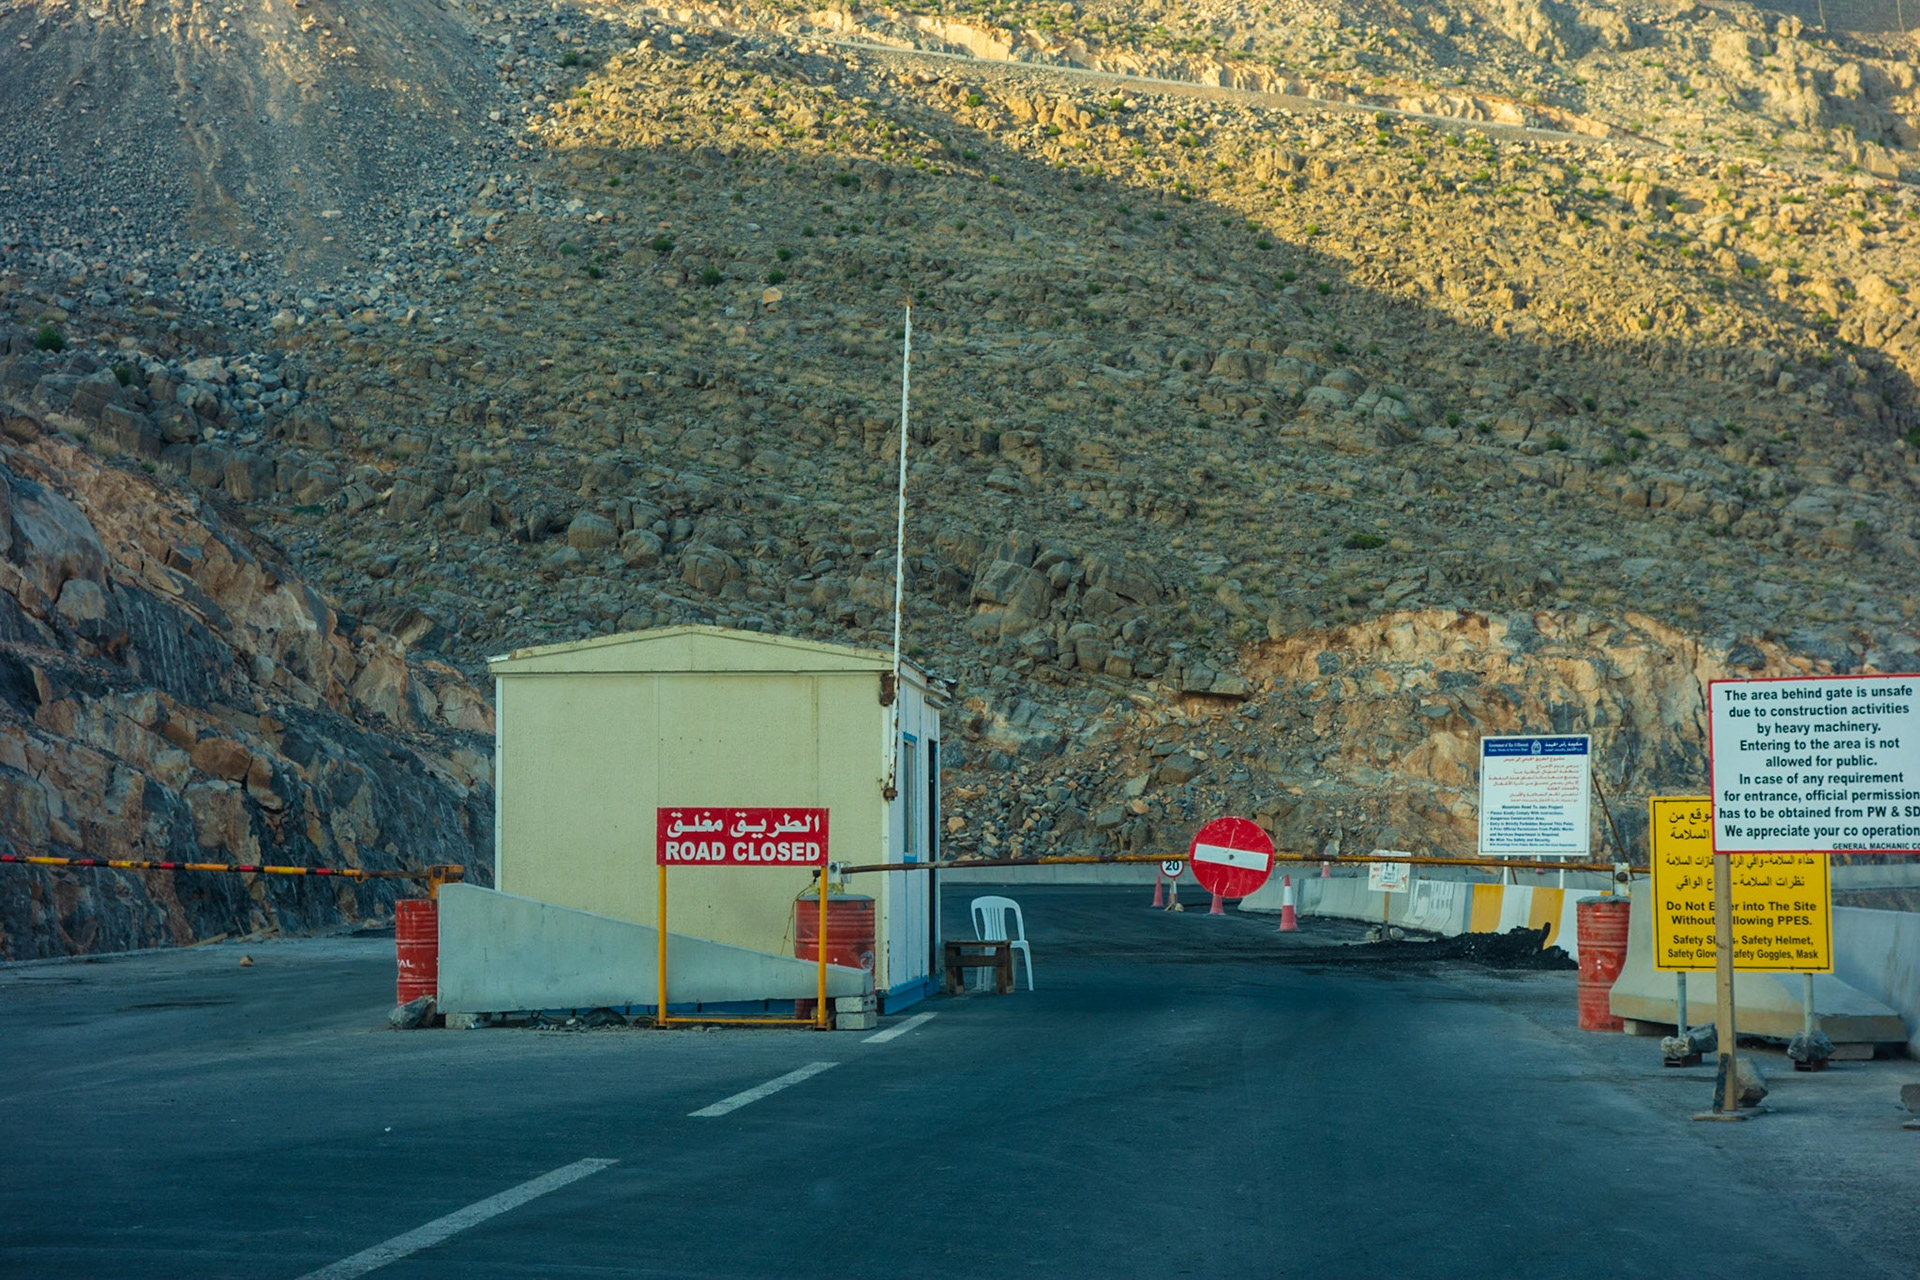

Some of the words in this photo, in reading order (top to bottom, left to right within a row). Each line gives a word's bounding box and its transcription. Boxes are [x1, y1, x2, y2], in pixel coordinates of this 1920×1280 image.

[1725, 690, 1747, 700] The
[1751, 692, 1777, 700] area
[1782, 688, 1821, 699] behind
[1826, 688, 1852, 701] gate
[1857, 687, 1867, 697] is
[1872, 685, 1912, 696] unsafe
[1729, 707, 1750, 717] due
[1755, 707, 1766, 717] to
[1771, 704, 1847, 716] construction
[1852, 703, 1909, 714] activities
[1757, 723, 1771, 736] by
[1775, 723, 1810, 735] heavy
[1814, 721, 1880, 734] machinery.
[1740, 740, 1790, 753] Entering
[1795, 740, 1806, 749] to
[1810, 739, 1829, 749] the
[1834, 741, 1860, 749] area
[1865, 738, 1875, 748] is
[1880, 738, 1899, 748] not
[1766, 756, 1811, 767] allowed
[1816, 756, 1832, 766] for
[1837, 755, 1877, 768] public.
[1740, 774, 1750, 784] In
[1755, 776, 1782, 784] case
[1787, 773, 1798, 784] of
[1803, 776, 1824, 786] any
[1828, 772, 1903, 785] requirement
[1724, 791, 1740, 801] for
[1744, 792, 1801, 802] entrance,
[1806, 790, 1847, 800] official
[1852, 789, 1920, 803] permission
[1669, 812, 1684, 823] من
[1720, 808, 1740, 818] has
[1744, 809, 1756, 818] to
[1760, 808, 1774, 818] be
[1779, 807, 1830, 818] obtained
[1835, 807, 1862, 817] from
[1868, 807, 1886, 817] PW
[1891, 806, 1899, 817] &
[667, 812, 723, 837] مغلق
[730, 812, 819, 838] الطريق
[1670, 827, 1710, 840] السلامة
[1725, 825, 1742, 836] We
[1747, 825, 1809, 839] appreciate
[1814, 827, 1840, 839] your
[1844, 827, 1858, 836] co
[666, 842, 725, 860] ROAD
[733, 842, 820, 861] CLOSED
[1165, 860, 1179, 871] 20
[1667, 901, 1681, 910] Do
[1686, 902, 1705, 911] Not
[1743, 902, 1764, 911] into
[1768, 902, 1789, 911] The
[1794, 901, 1816, 911] Site
[1672, 916, 1715, 925] Without
[1778, 916, 1812, 925] PPES.
[1673, 935, 1703, 946] Safety
[1742, 935, 1772, 947] Safety
[1776, 936, 1813, 946] Helmet,
[1668, 949, 1694, 960] Safety
[1734, 950, 1755, 960] afety
[1757, 950, 1793, 960] Goggles,
[1796, 950, 1818, 959] Mask
